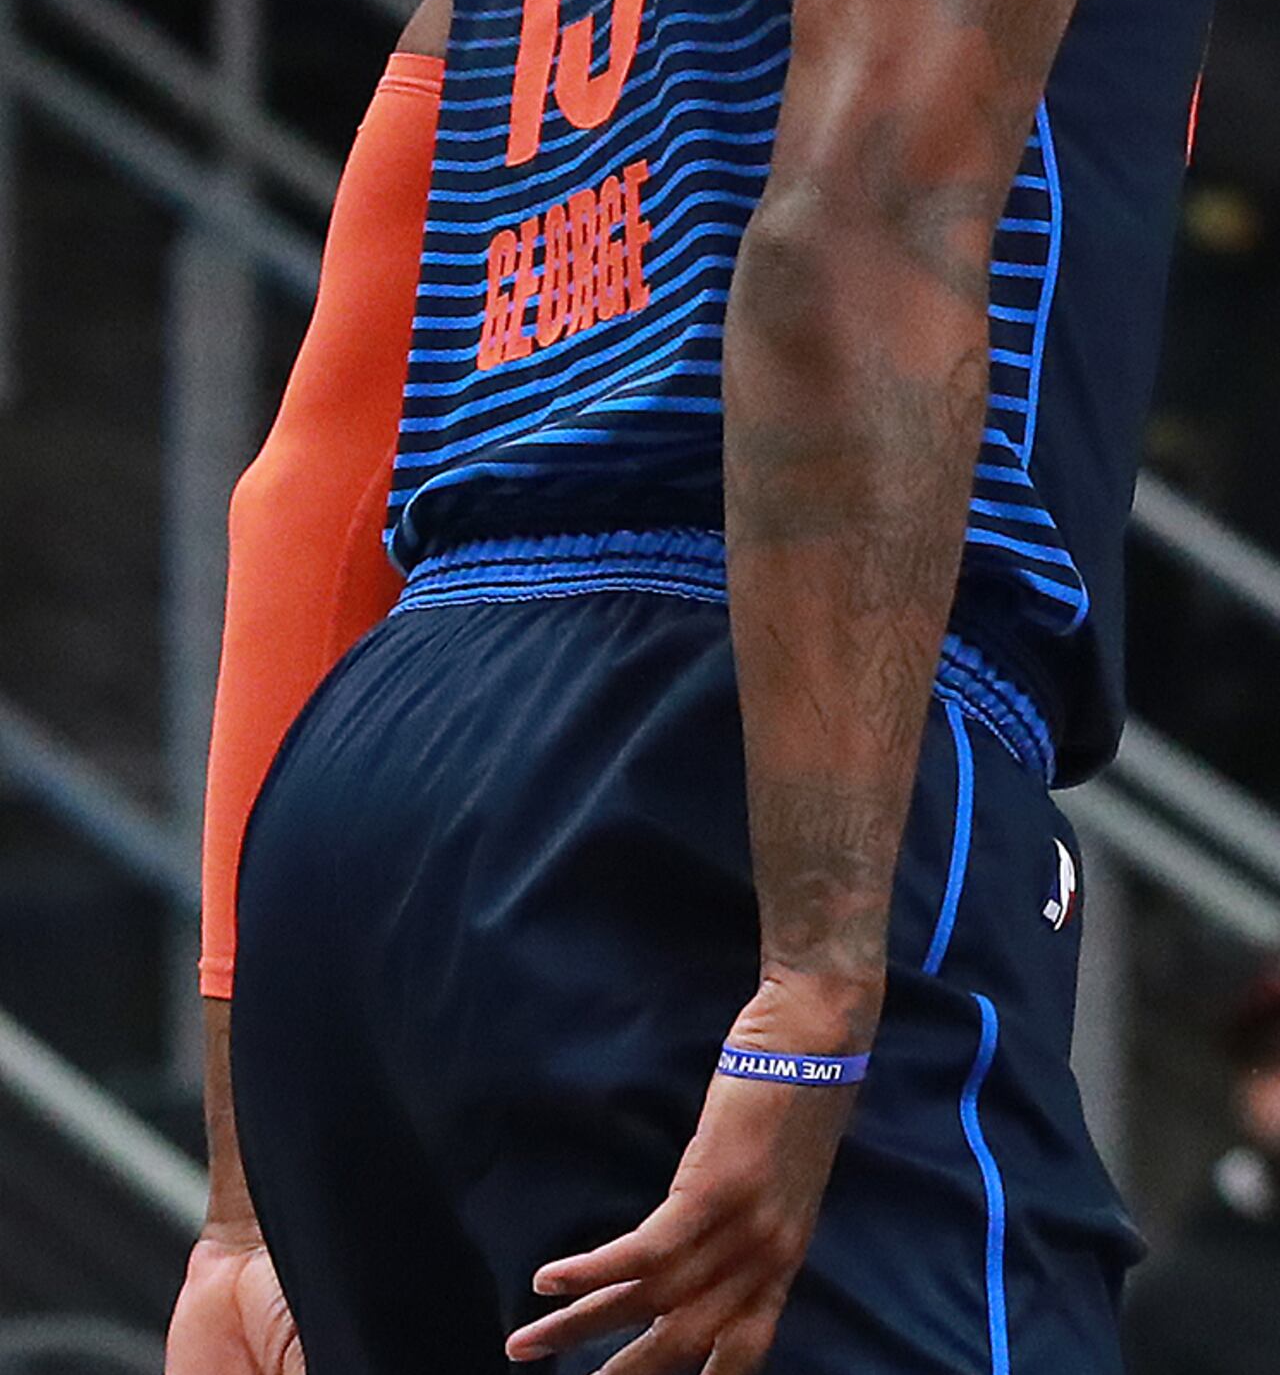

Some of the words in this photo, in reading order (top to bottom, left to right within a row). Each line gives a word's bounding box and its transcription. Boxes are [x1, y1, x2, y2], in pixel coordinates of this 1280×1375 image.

[476, 158, 650, 371] GEORGE
[738, 1056, 798, 1078] WITH
[801, 1061, 842, 1080] LIVE
